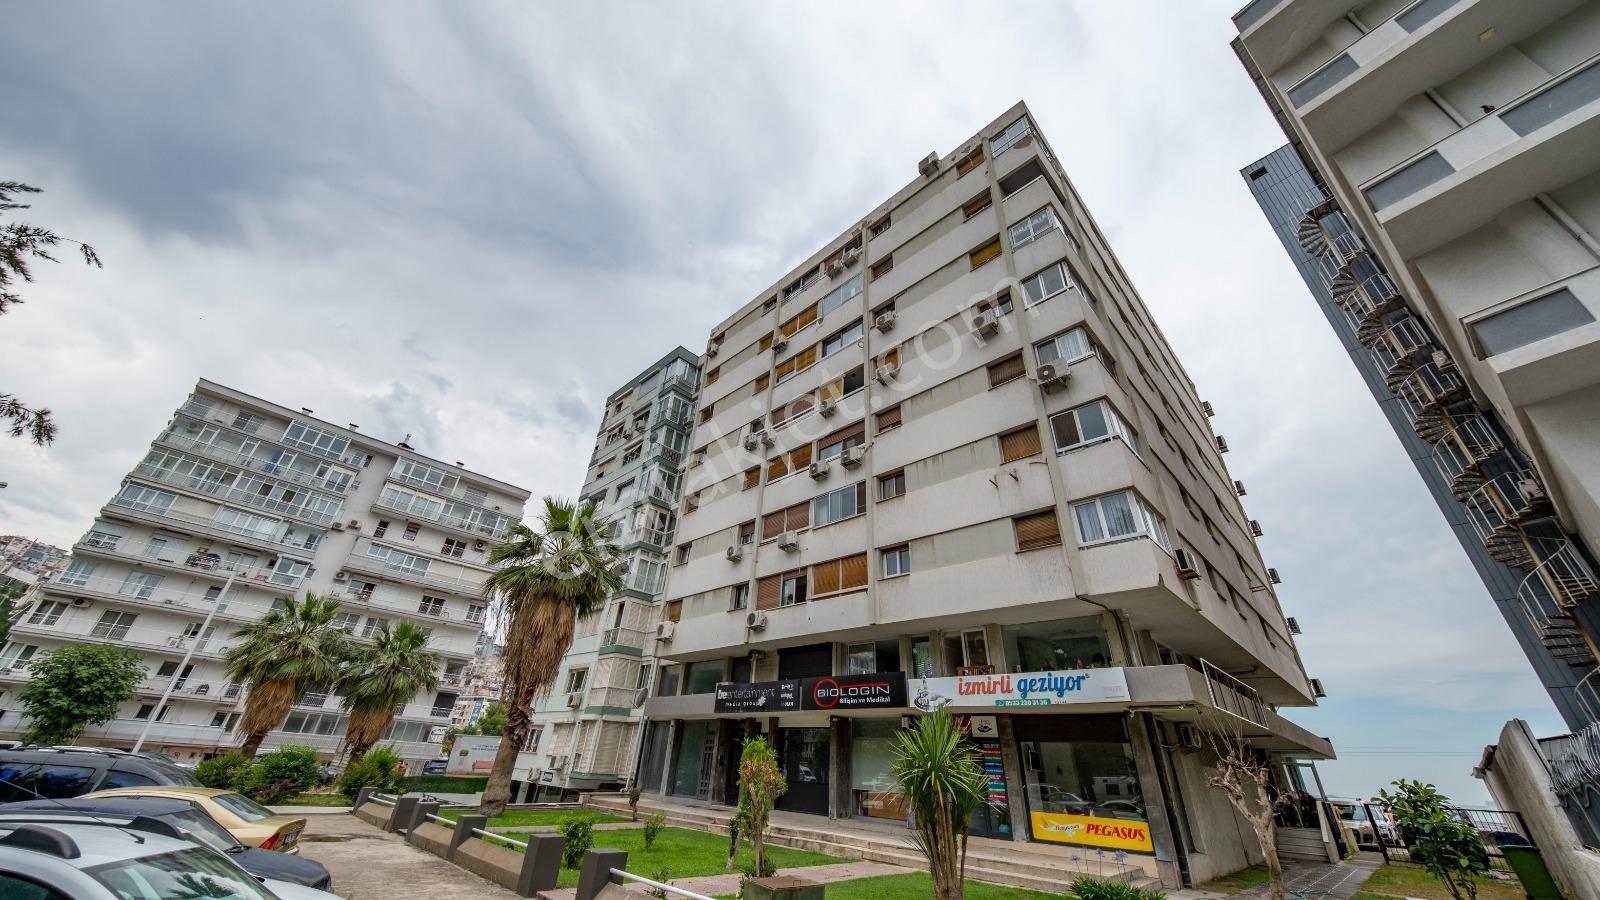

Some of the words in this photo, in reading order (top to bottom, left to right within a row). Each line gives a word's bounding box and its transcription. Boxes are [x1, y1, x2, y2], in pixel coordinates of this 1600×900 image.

[817, 685, 890, 698] BIOLOGIN
[958, 675, 1013, 695] izmirli
[1017, 672, 1086, 698] geziyor
[1086, 823, 1146, 842] PEGASUS
